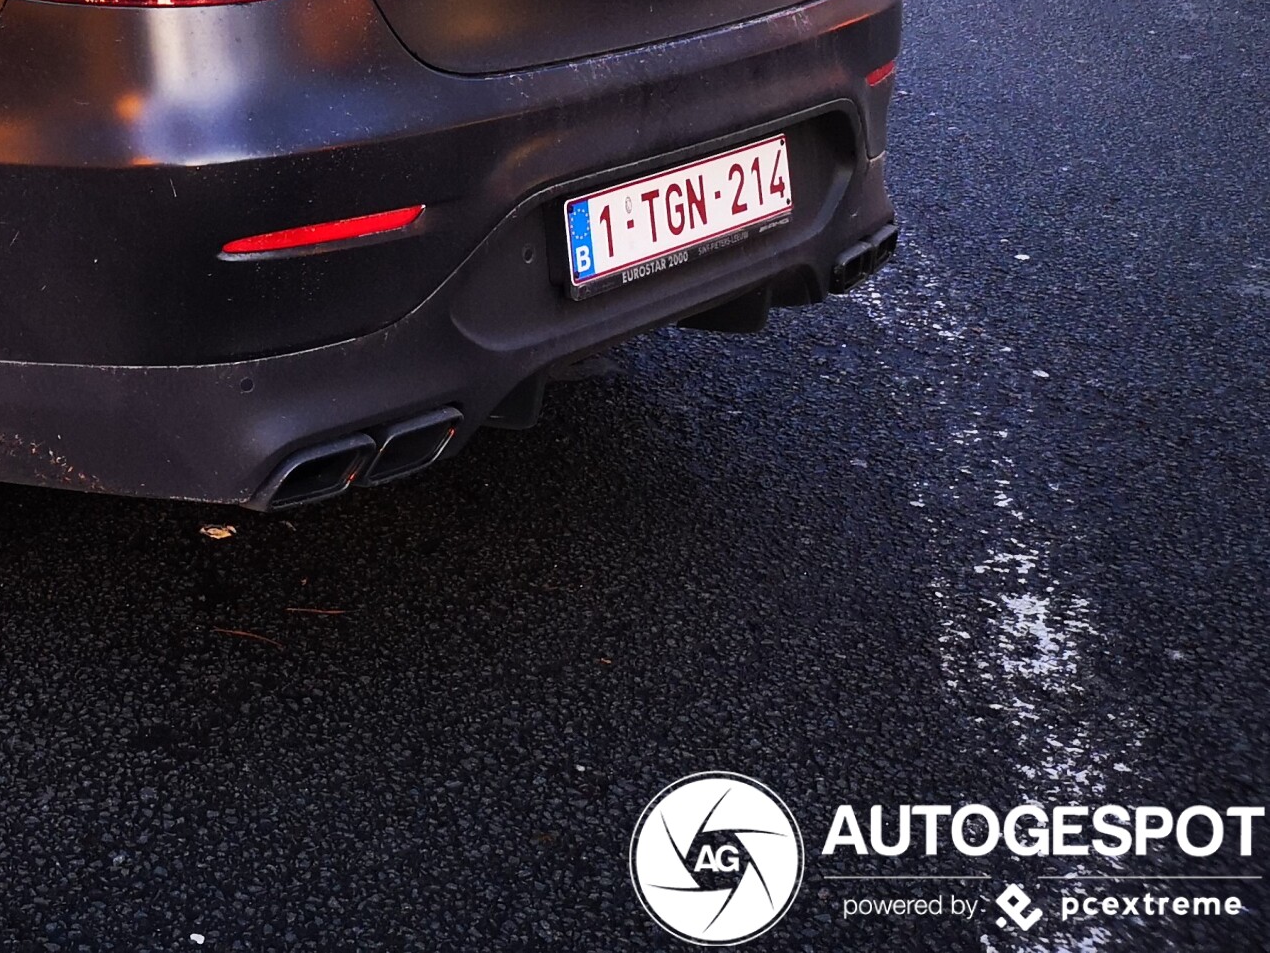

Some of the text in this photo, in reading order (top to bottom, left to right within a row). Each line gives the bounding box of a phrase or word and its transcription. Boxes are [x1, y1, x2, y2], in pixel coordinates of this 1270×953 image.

[599, 149, 785, 258] 1-TGN-214
[575, 245, 591, 272] B
[621, 259, 666, 284] EUROSTAR
[668, 251, 689, 267] 2000
